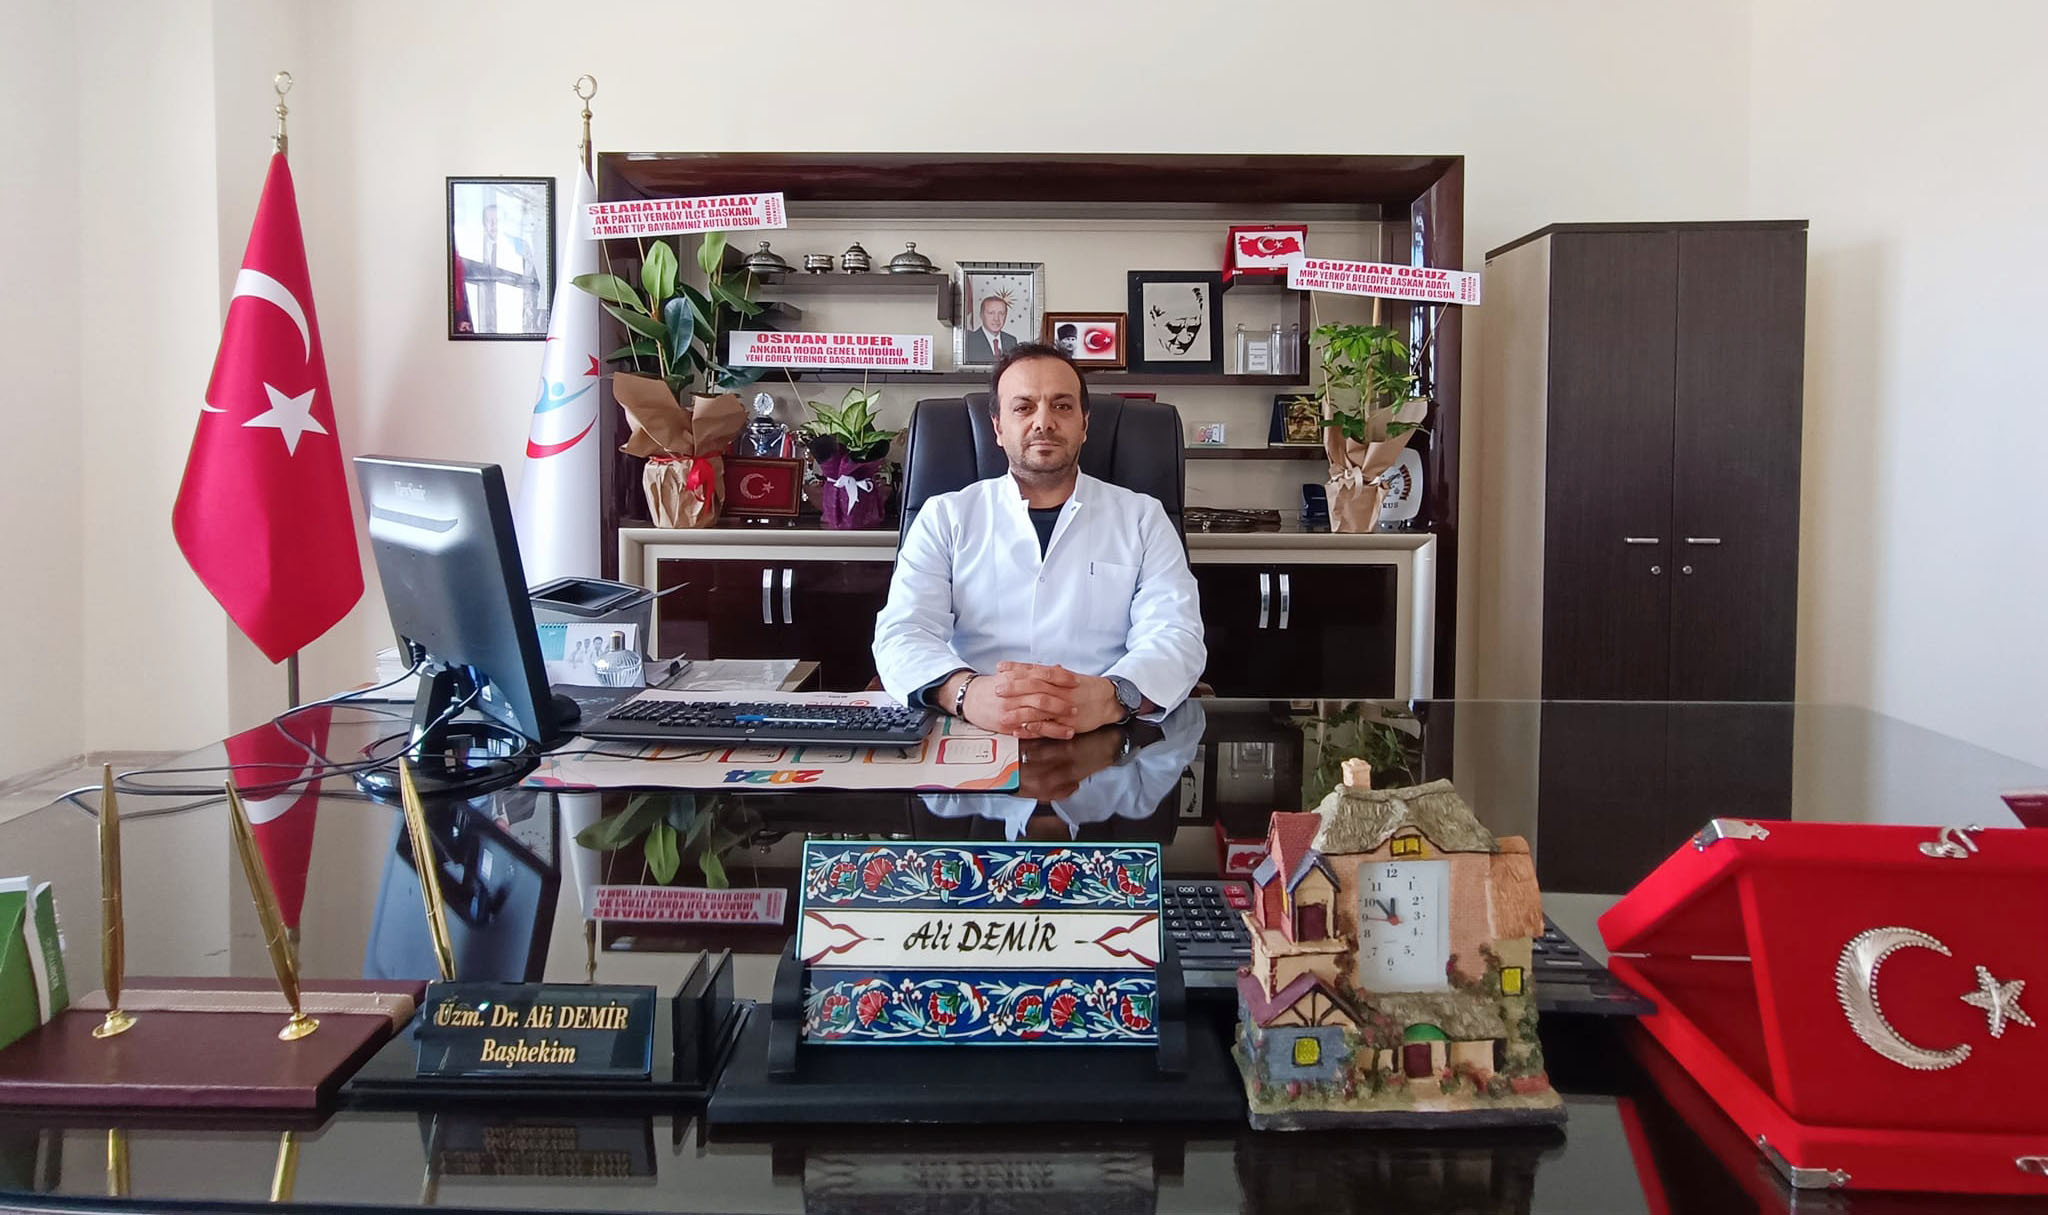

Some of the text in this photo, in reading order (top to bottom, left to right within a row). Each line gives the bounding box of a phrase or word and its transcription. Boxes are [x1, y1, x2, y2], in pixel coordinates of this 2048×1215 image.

[697, 196, 758, 209] ATALAY
[595, 215, 609, 225] AK
[592, 227, 602, 236] 14
[604, 225, 629, 235] MART
[631, 224, 646, 233] TIP
[648, 220, 701, 232] BAYRAMINIZ
[733, 216, 760, 226] OLSUN
[1299, 269, 1318, 278] MHP
[1425, 280, 1450, 290] ADAYI
[1295, 278, 1455, 299] 14 MART TIP BAYRAMINIZ KUTLU OLSUN
[757, 333, 893, 346] OSMAN ULUER
[750, 345, 791, 354] ANKARA
[793, 346, 823, 355] MODA
[826, 347, 856, 356] GENEL
[722, 769, 825, 785] 2024
[1386, 868, 1398, 878] 12
[1371, 882, 1382, 892] 11
[1408, 880, 1413, 890] 1
[1363, 898, 1376, 908] 10
[1412, 896, 1419, 906] 2
[1361, 912, 1369, 923] 9
[1414, 911, 1420, 921] 3
[902, 914, 1058, 956] Ali DEMİR
[1364, 929, 1371, 938] 8
[1371, 947, 1378, 956] 7
[1403, 945, 1411, 955] 5
[1387, 957, 1394, 967] 6
[491, 1004, 519, 1028] Dr.
[524, 1005, 553, 1029] Ali
[557, 1001, 629, 1030] DEMİR
[480, 1038, 577, 1068] Başhekim
